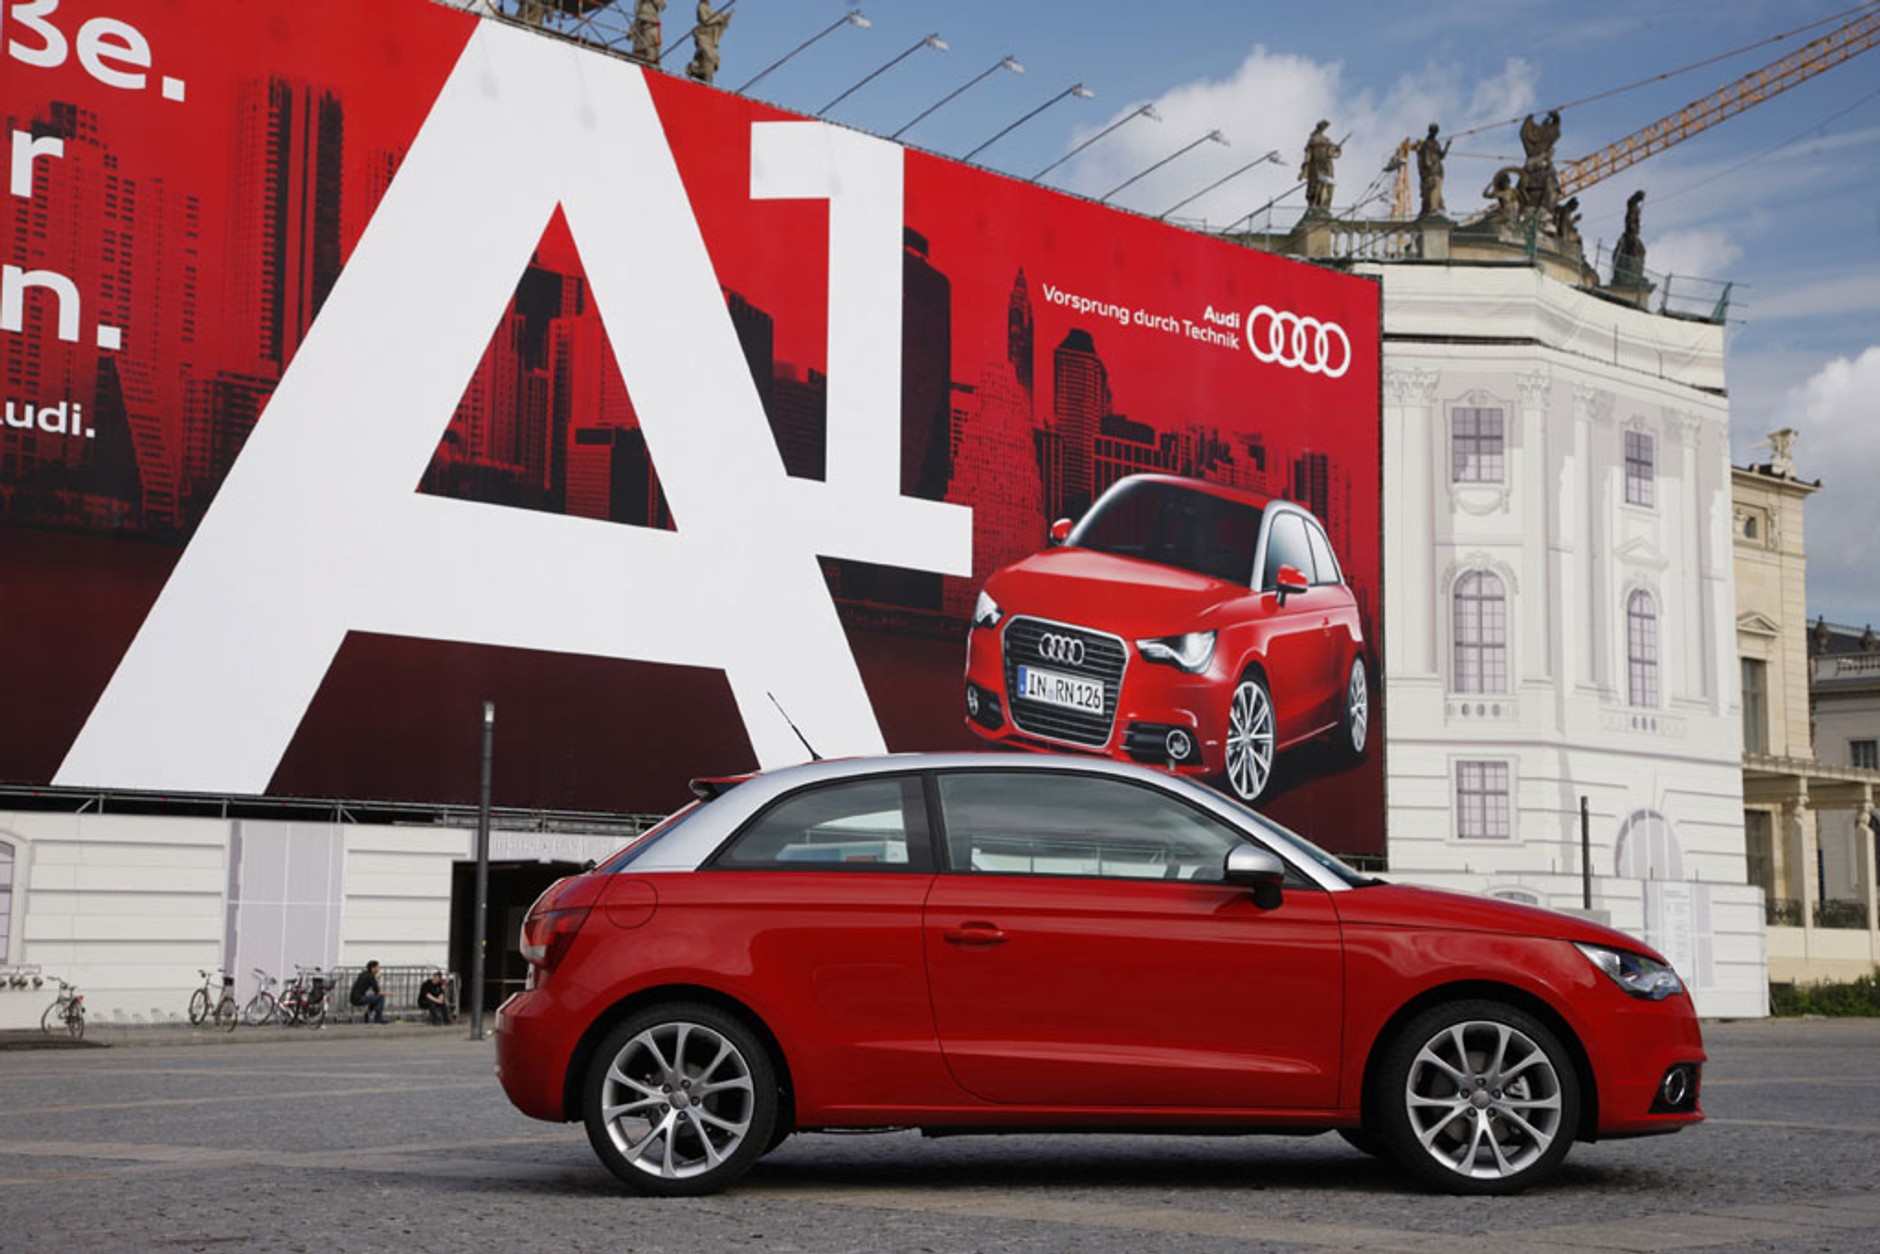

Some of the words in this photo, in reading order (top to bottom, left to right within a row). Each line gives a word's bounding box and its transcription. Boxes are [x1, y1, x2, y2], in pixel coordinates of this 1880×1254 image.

[1043, 284, 1129, 325] Vorsprung
[1133, 308, 1179, 334] durch
[1183, 320, 1239, 350] Technik
[1203, 305, 1240, 329] Audi
[0, 401, 95, 438] udi.
[50, 16, 973, 797] A1
